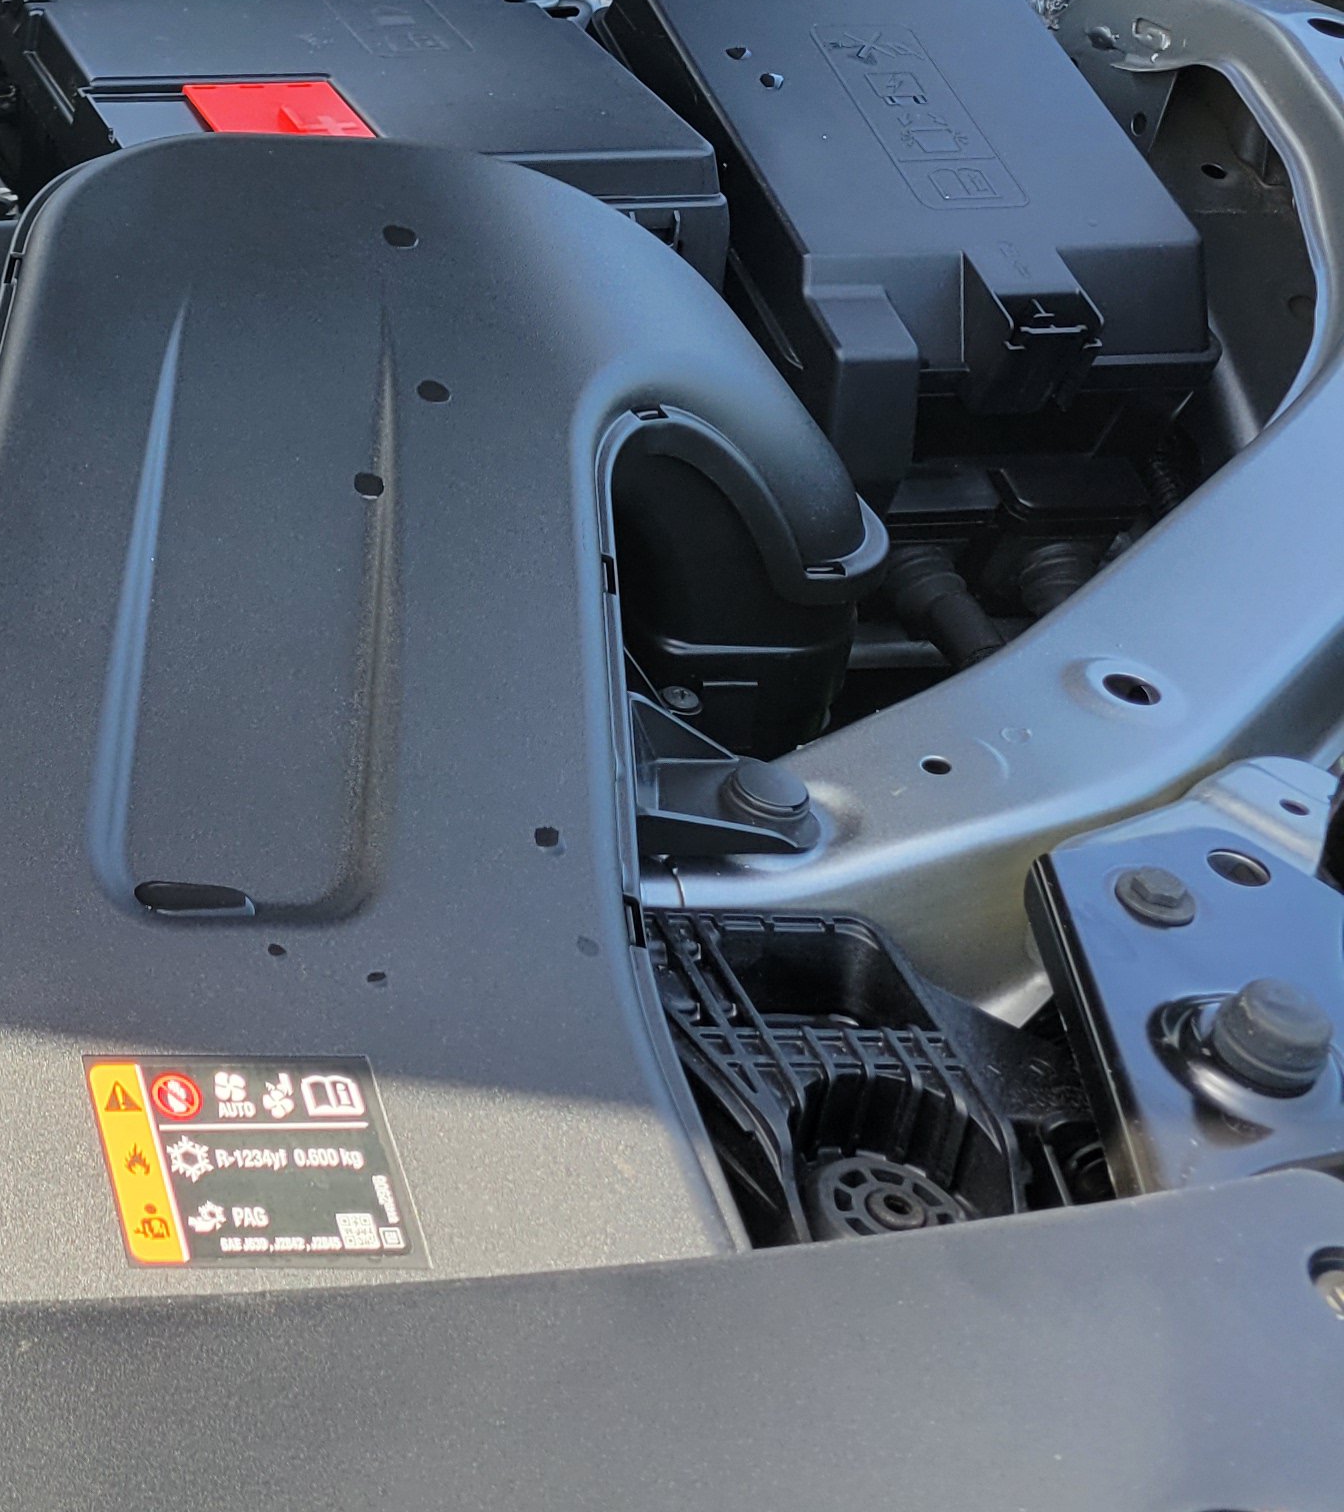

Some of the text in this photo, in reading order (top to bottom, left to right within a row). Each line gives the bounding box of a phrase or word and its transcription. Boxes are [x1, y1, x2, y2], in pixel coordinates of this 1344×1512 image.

[218, 1101, 256, 1119] AUTO
[215, 1147, 365, 1172] R-1234yf 0.600 kg
[232, 1206, 269, 1228] PAG
